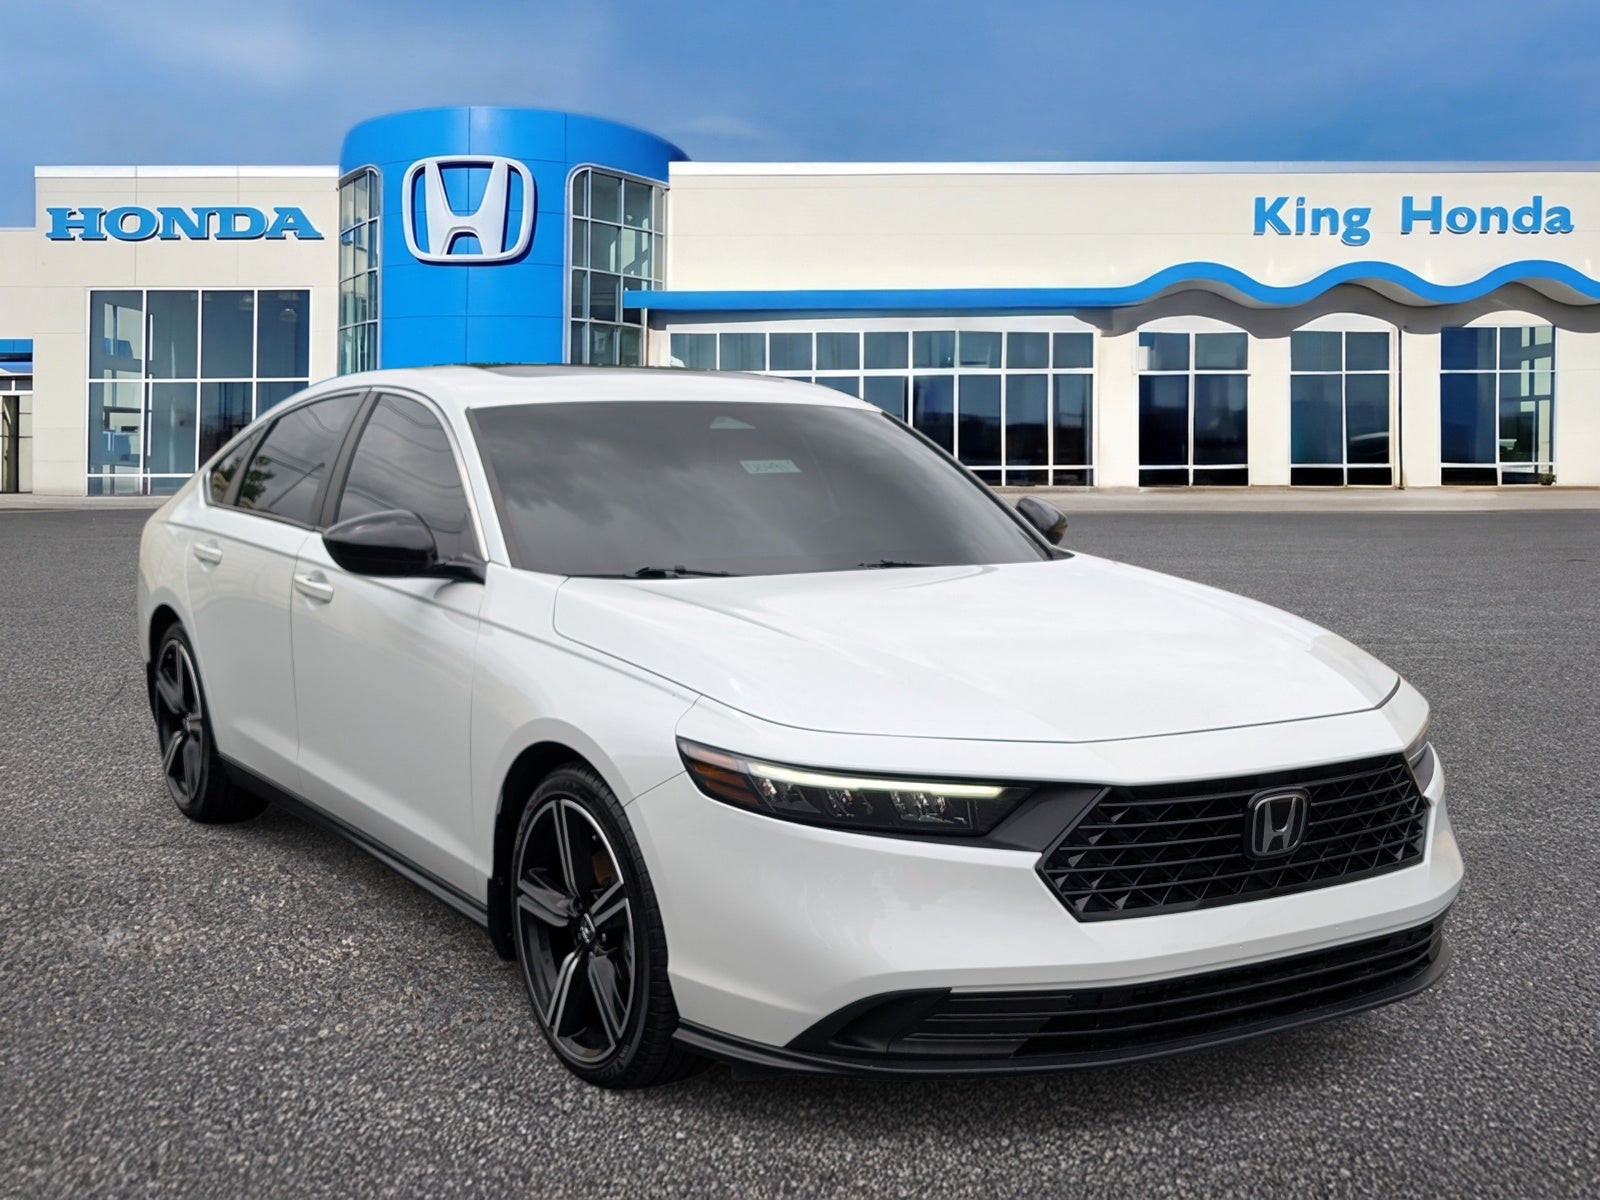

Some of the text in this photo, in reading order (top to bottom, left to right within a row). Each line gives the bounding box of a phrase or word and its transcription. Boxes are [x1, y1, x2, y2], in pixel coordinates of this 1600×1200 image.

[46, 206, 324, 241] HONDA
[1253, 195, 1574, 246] King Honda
